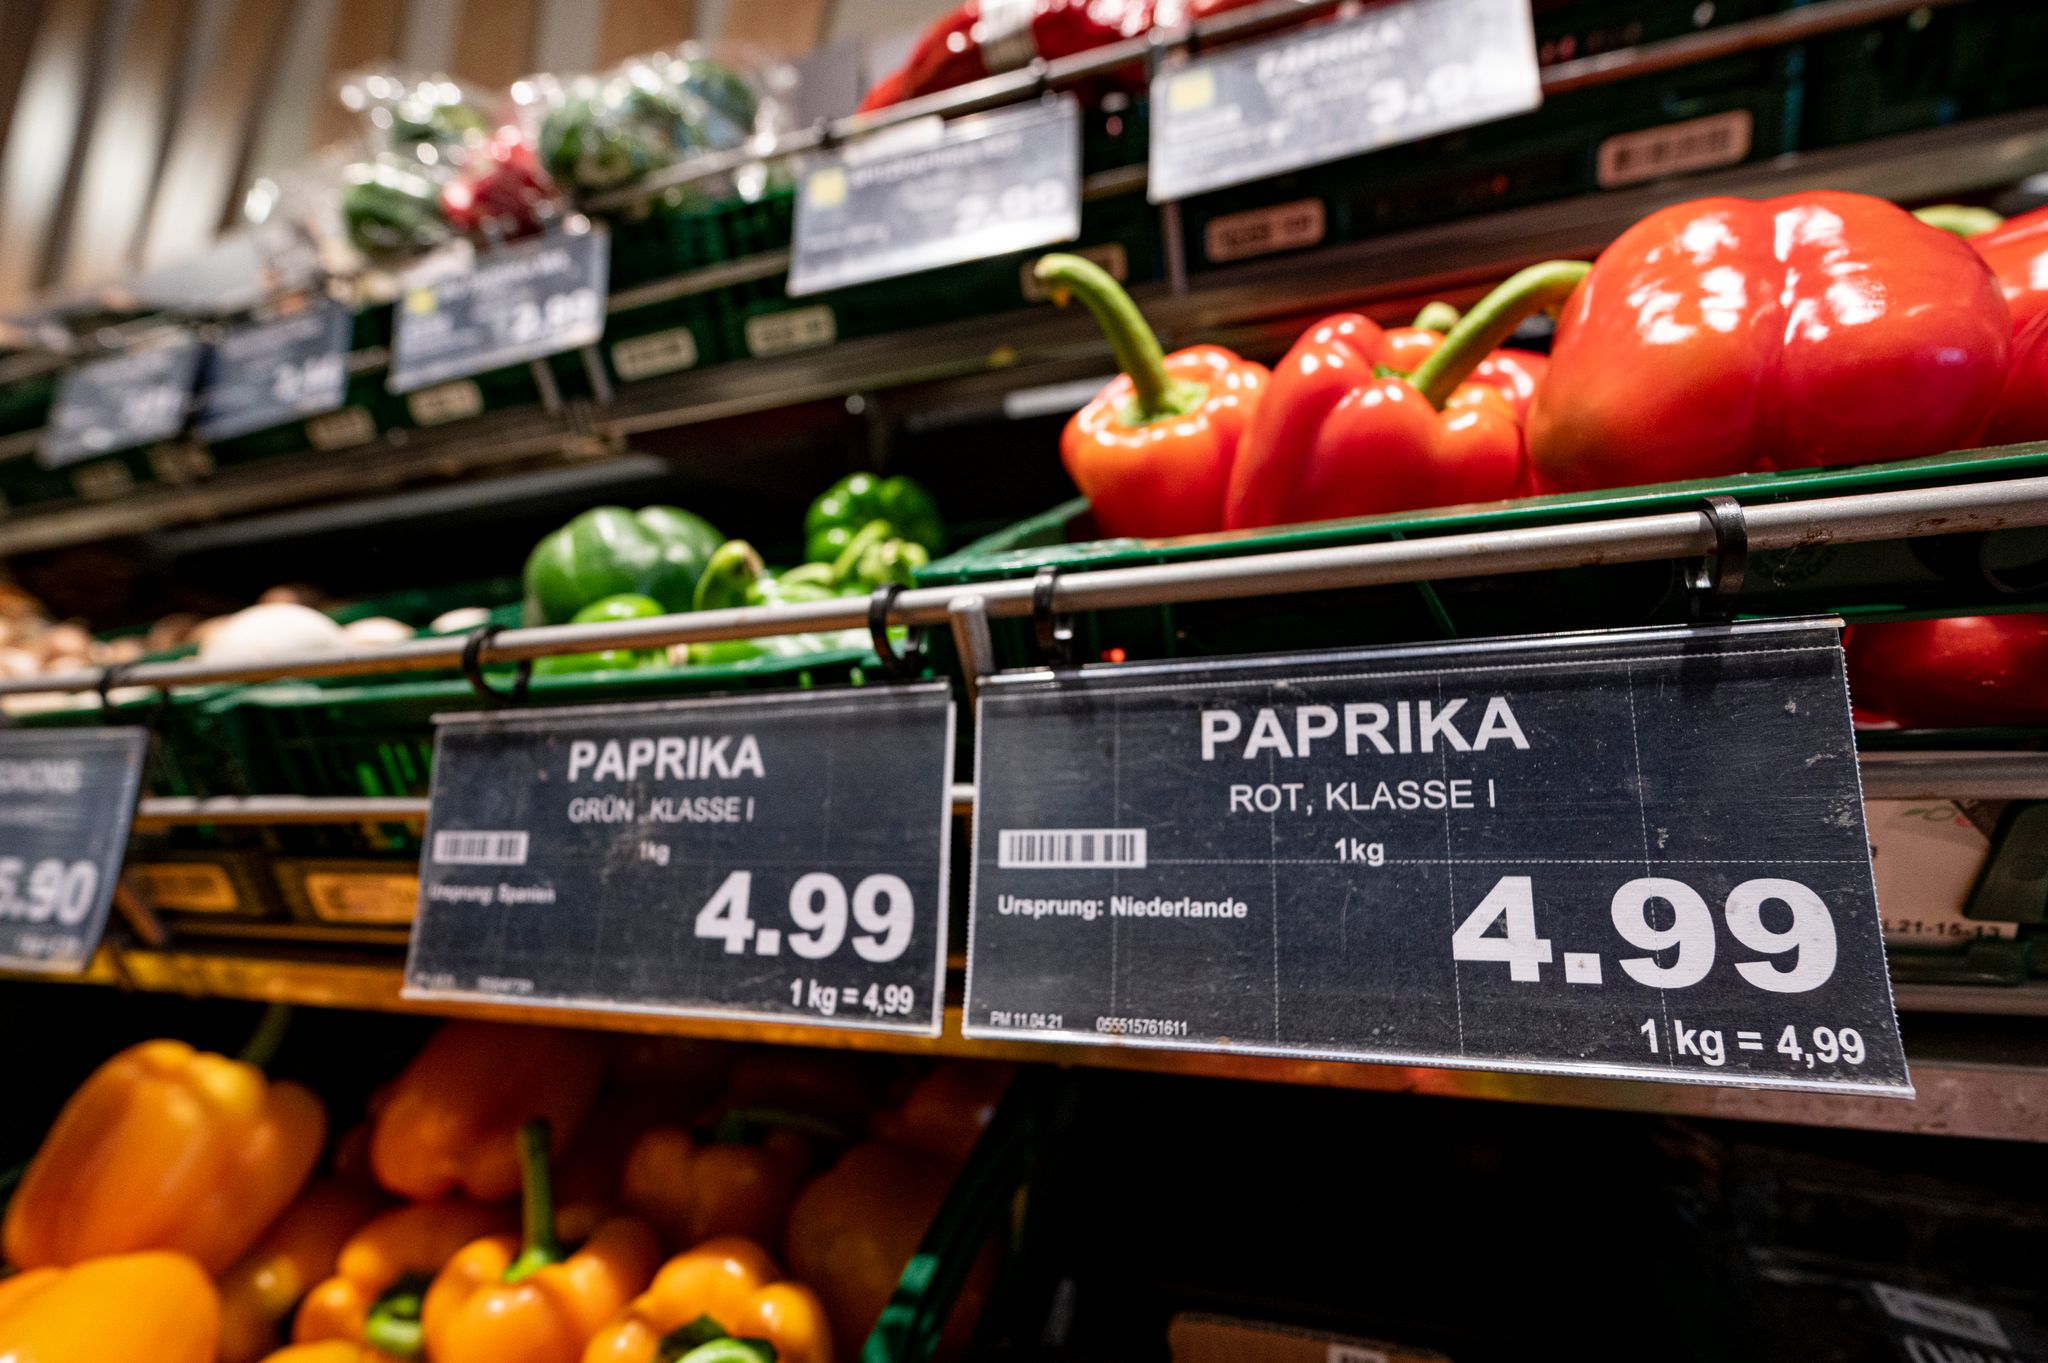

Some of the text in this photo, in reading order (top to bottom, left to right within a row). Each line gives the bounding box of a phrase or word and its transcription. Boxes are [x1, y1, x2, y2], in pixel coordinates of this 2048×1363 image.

[1200, 696, 1531, 761] PAPRIKA
[567, 734, 766, 782] PAPRIKA
[649, 796, 741, 824] KLASSE
[745, 796, 755, 822] I
[1230, 778, 1497, 816] ROT, KLASSE I
[1333, 837, 1386, 866] 1kg
[694, 870, 915, 963] 4.99
[997, 894, 1248, 921] Ursprung: Niederlande
[1451, 875, 1838, 994] 4.99
[789, 978, 915, 1017] 1 kg = 4,99
[1640, 1018, 1866, 1068] 1 kg = 4,99
